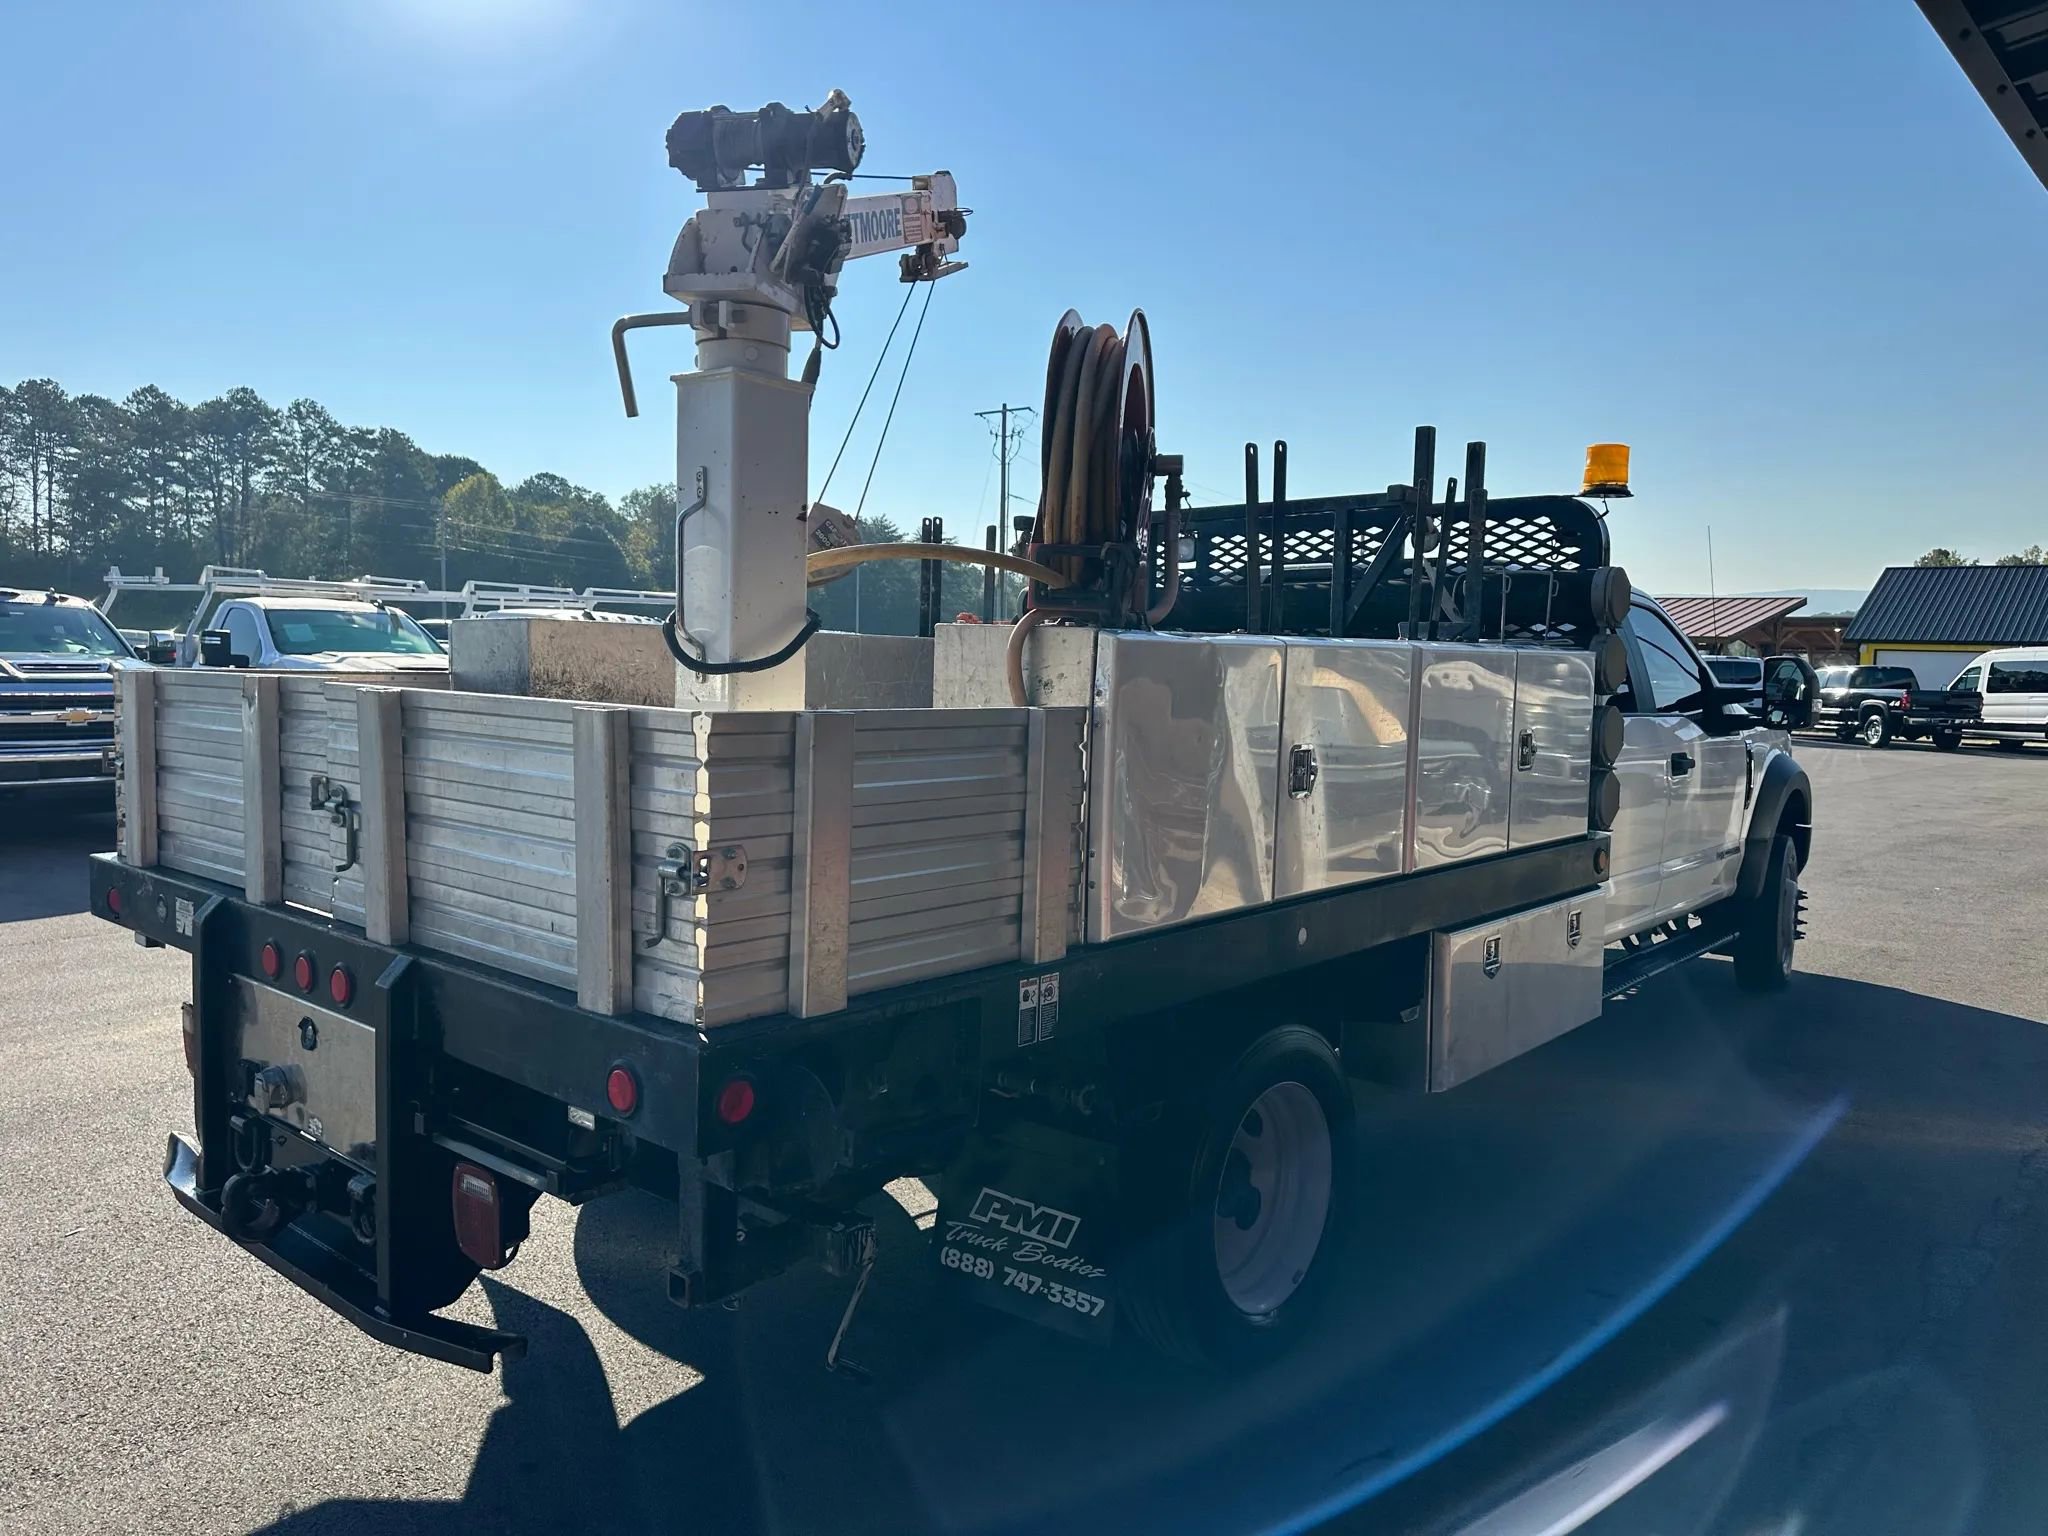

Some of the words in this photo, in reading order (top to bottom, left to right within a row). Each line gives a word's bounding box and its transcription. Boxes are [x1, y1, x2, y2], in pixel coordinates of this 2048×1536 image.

[847, 208, 901, 243] TMOORE
[969, 1187, 1081, 1248] PMI
[946, 1221, 1008, 1251] Truck
[1013, 1241, 1107, 1278] Bodies
[941, 1246, 994, 1279] (888)
[1003, 1266, 1105, 1316] 747-3357
